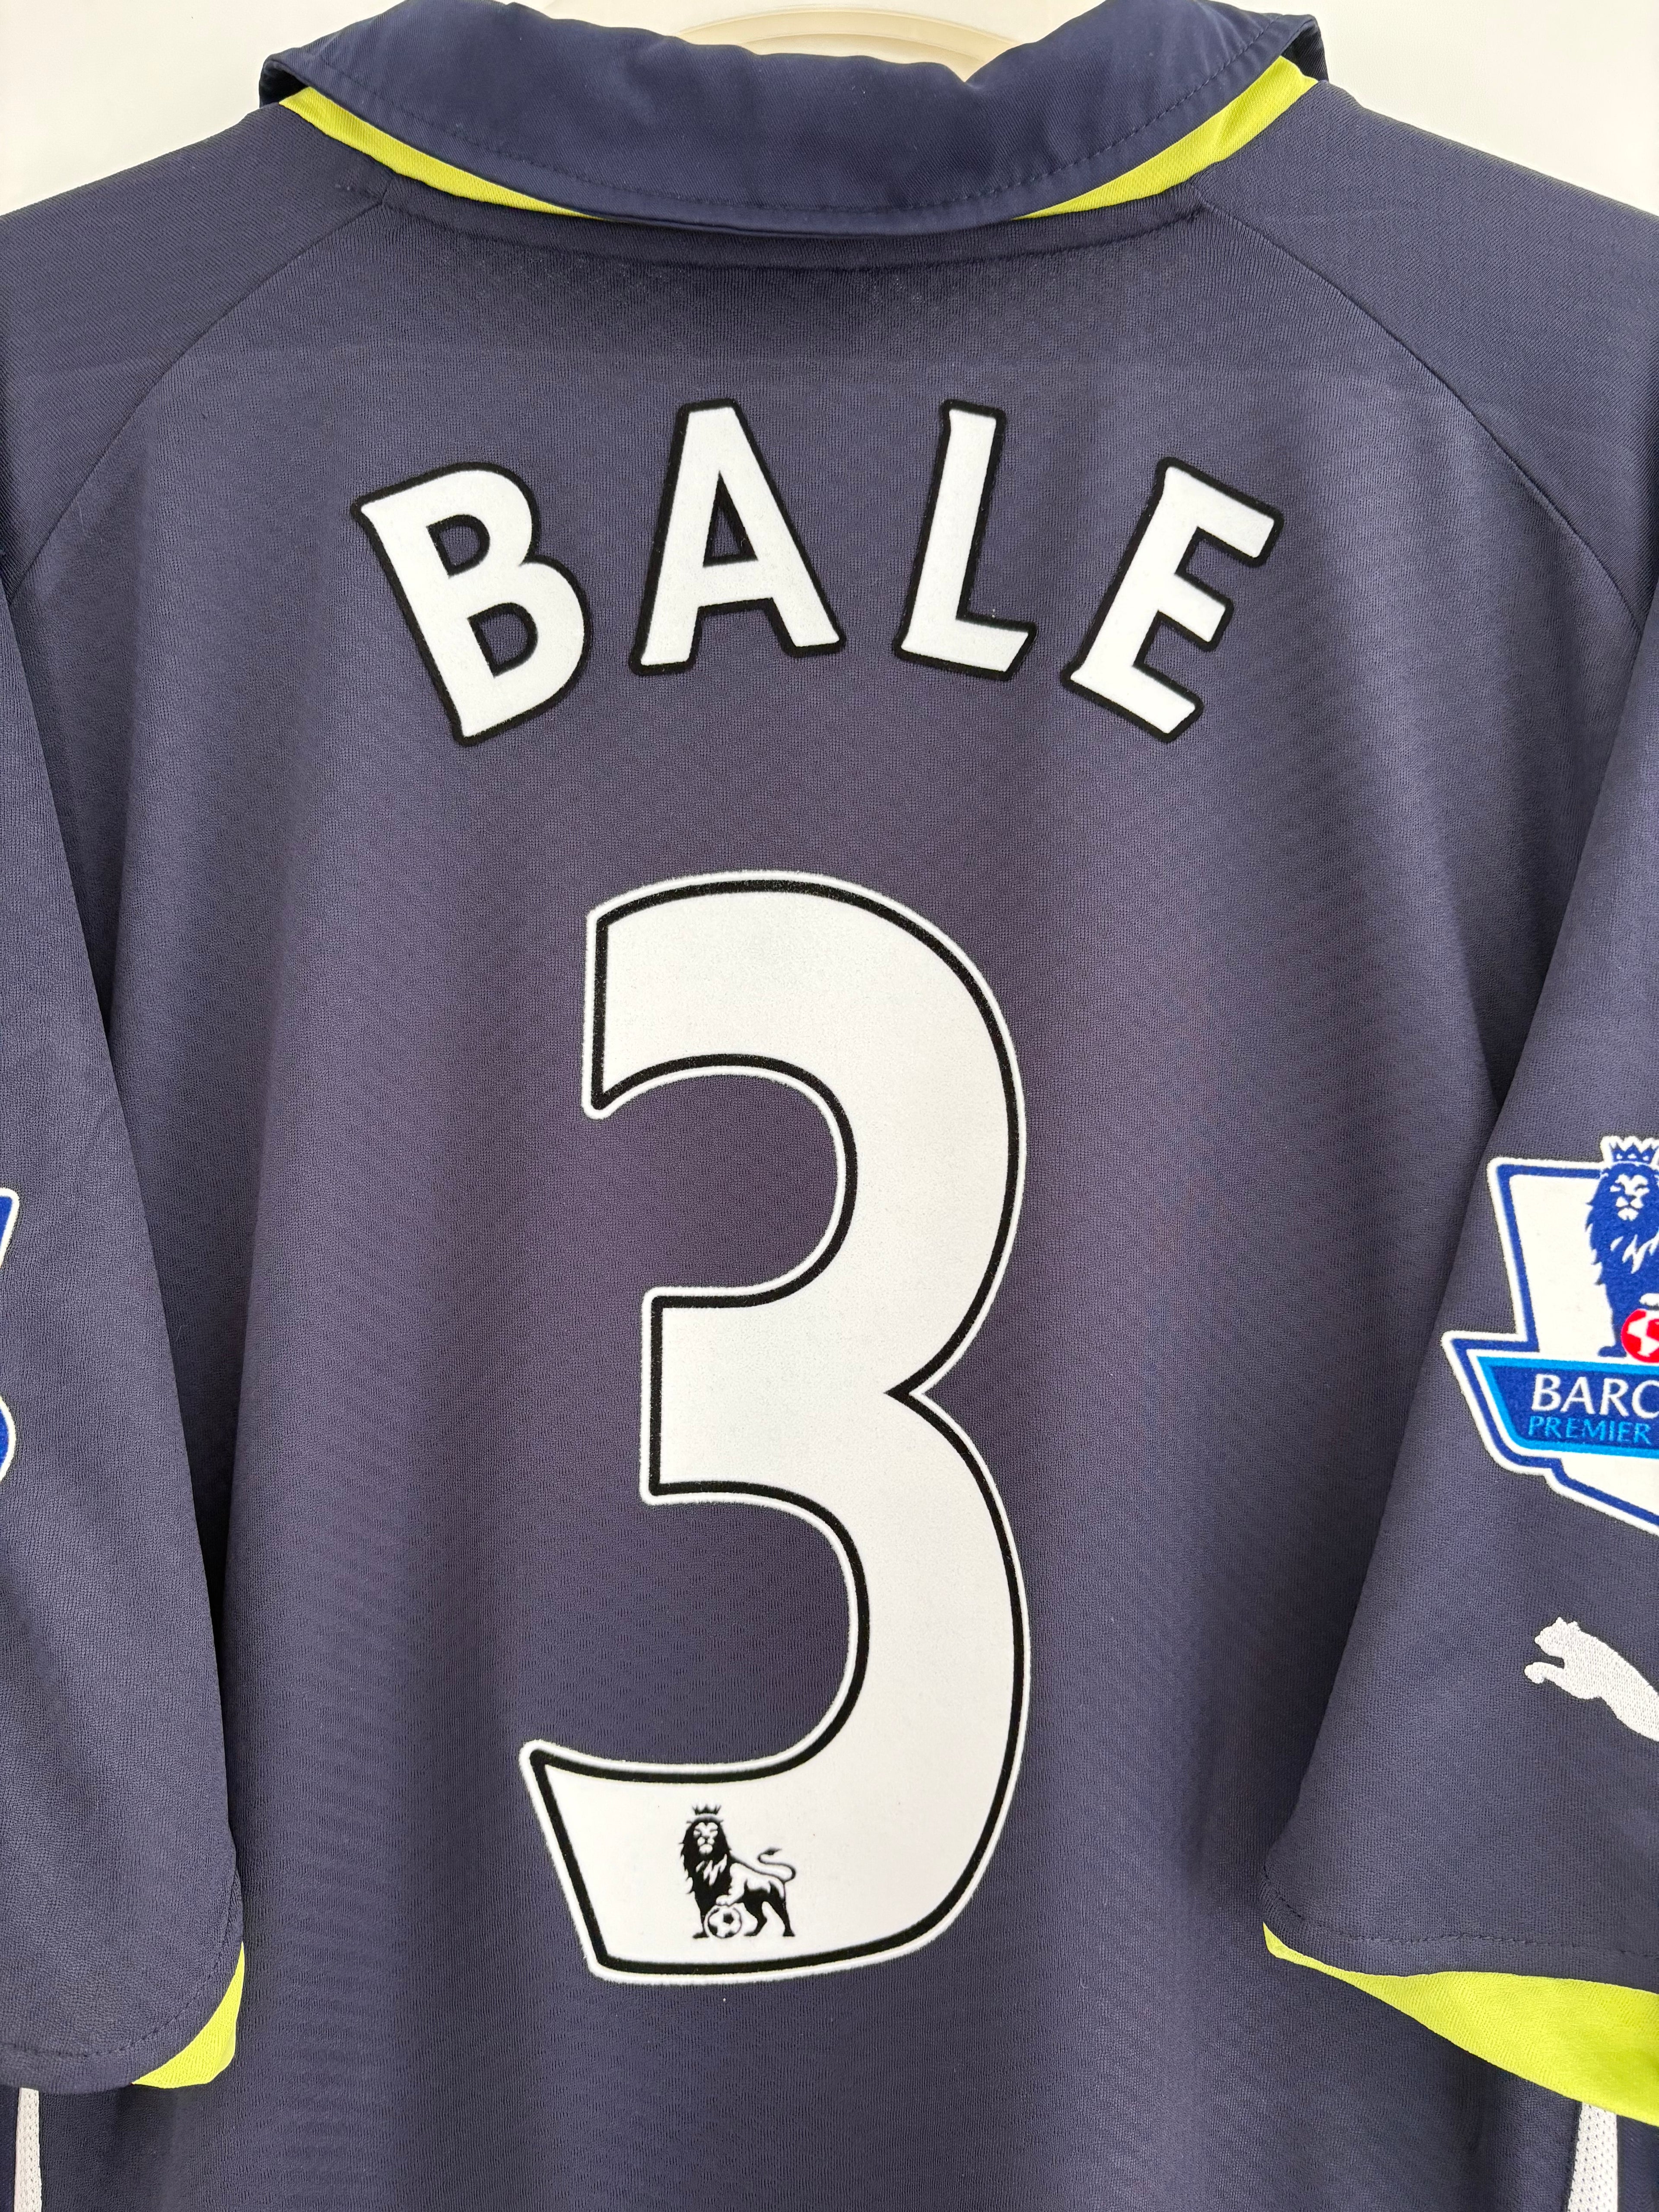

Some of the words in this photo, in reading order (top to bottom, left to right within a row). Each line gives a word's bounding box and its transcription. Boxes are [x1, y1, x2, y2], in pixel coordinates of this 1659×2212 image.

[351, 398, 1284, 745] BALE
[520, 871, 1030, 1986] 3
[1528, 1415, 1651, 1445] PREMIER
[1531, 1373, 1659, 1419] BARC
